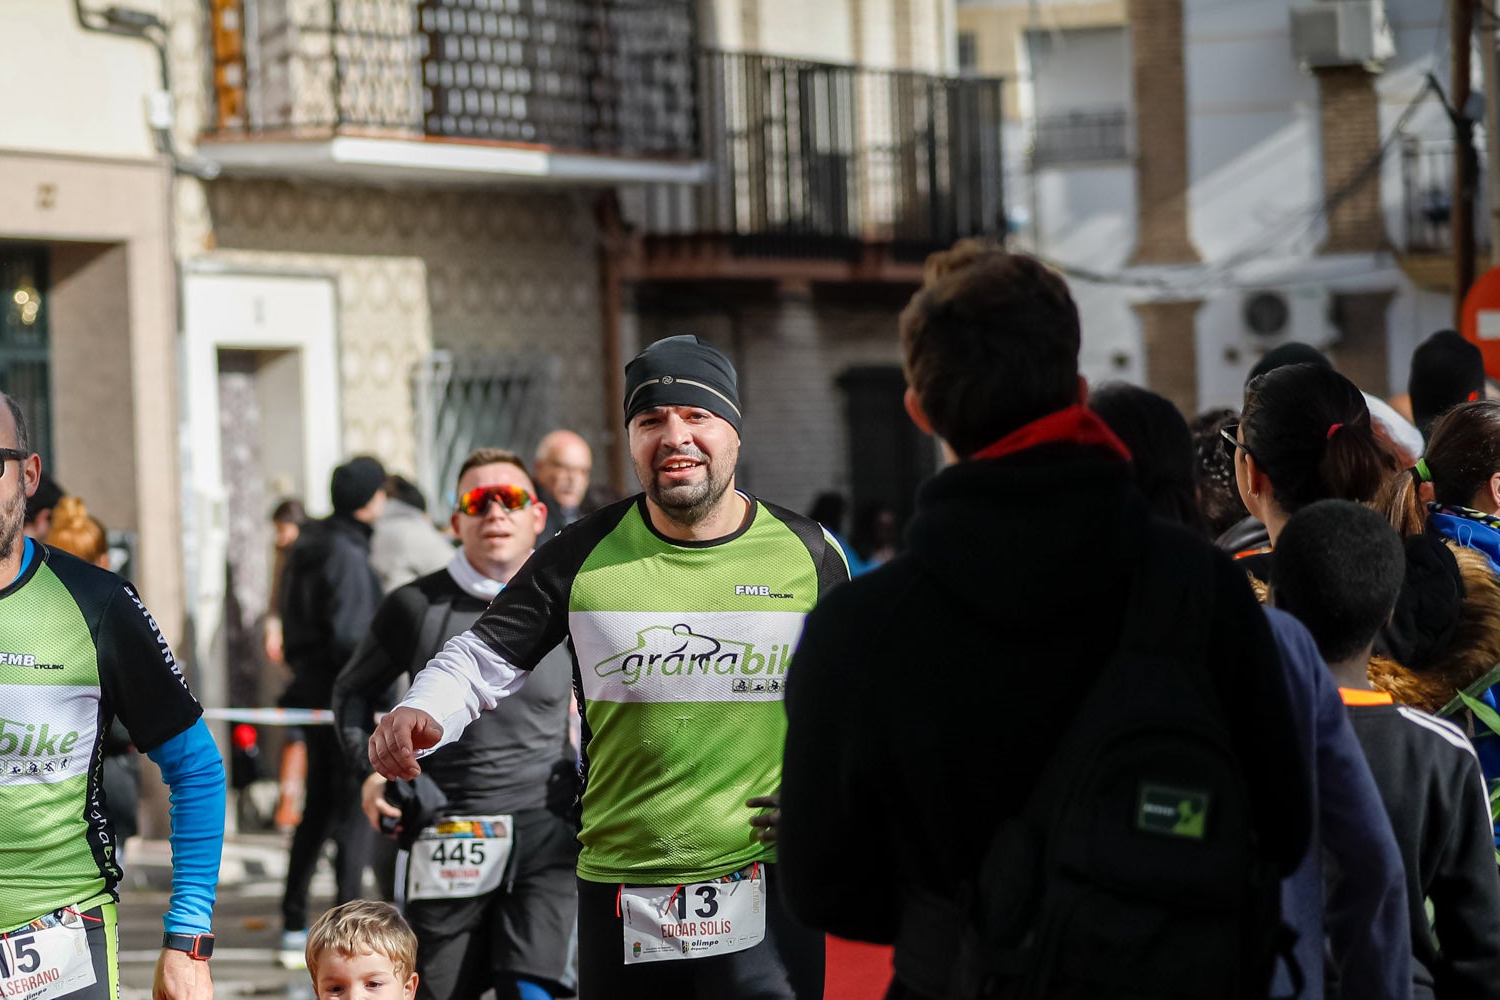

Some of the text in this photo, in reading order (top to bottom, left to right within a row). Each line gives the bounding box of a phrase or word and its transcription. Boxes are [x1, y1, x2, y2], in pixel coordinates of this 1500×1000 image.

[735, 585, 770, 596] FMB
[431, 841, 485, 865] 445
[675, 885, 719, 919] 13
[661, 922, 697, 938] EDGAR
[692, 939, 719, 947] olimpo
